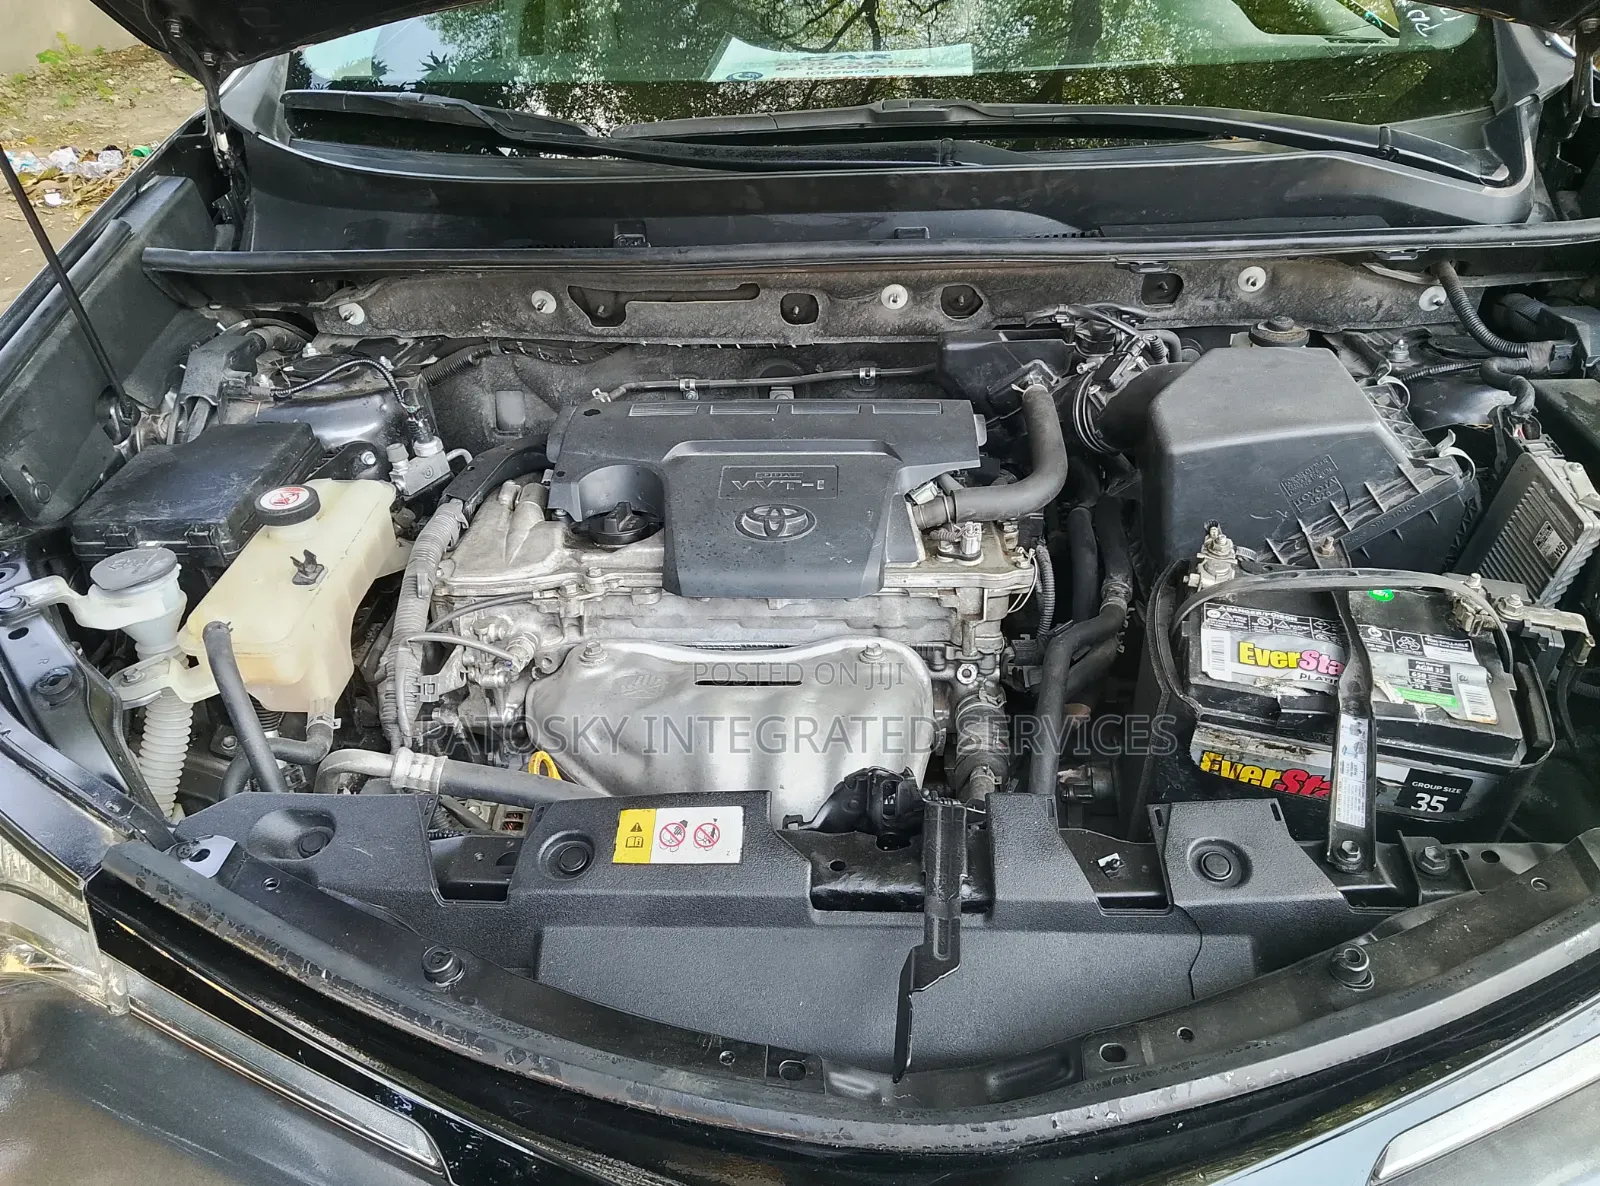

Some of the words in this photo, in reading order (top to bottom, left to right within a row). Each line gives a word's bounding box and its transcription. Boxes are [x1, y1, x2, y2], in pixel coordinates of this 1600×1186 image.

[1294, 477, 1341, 507] TOYOTA
[1238, 641, 1345, 676] EverSta
[1415, 664, 1434, 673] AGM
[1411, 671, 1427, 679] 650
[1200, 751, 1330, 798] EverSta
[1411, 781, 1443, 791] GROUP
[1443, 786, 1463, 794] SIZE
[1410, 792, 1449, 813] 35
